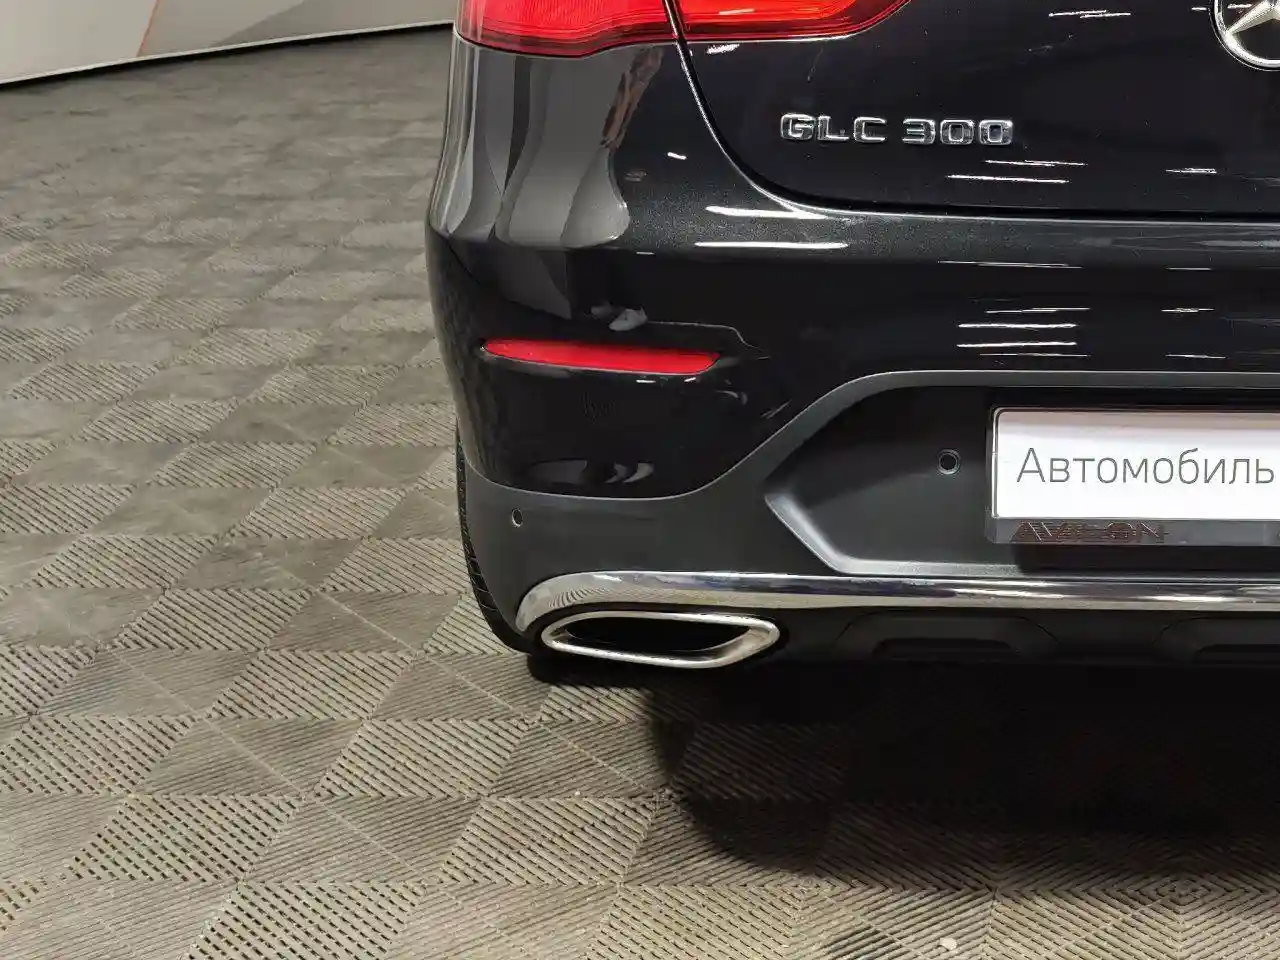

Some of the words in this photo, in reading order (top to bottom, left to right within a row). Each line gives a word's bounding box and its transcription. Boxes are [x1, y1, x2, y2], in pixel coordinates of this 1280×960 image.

[780, 112, 887, 143] GLC
[902, 118, 1013, 145] 300
[1016, 447, 1275, 485] Автомобиль
